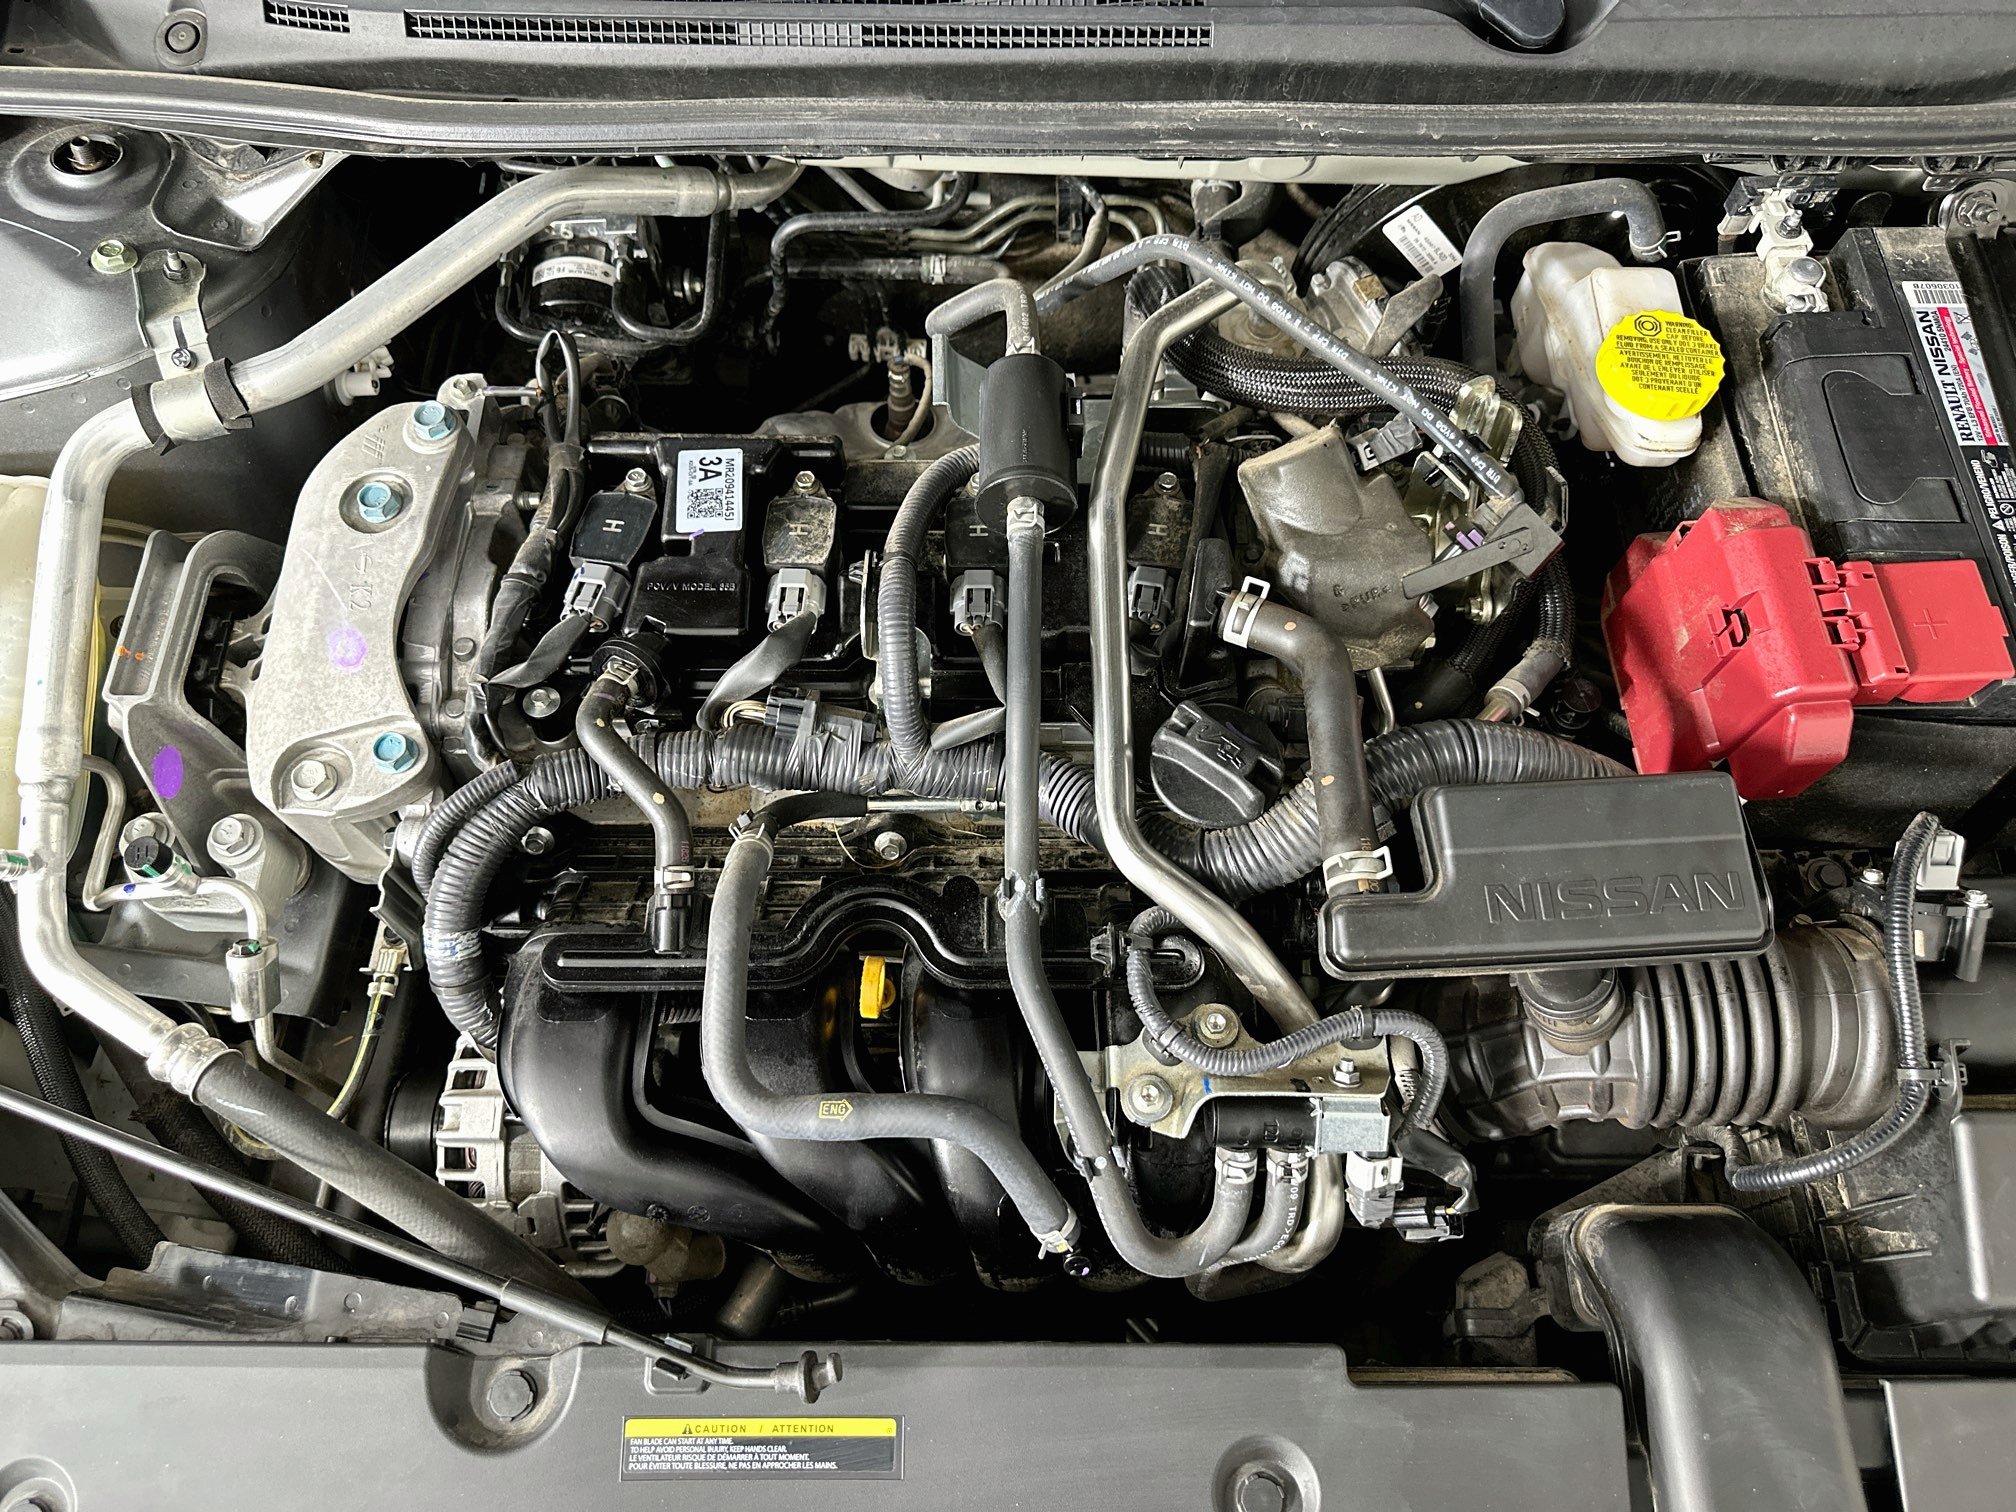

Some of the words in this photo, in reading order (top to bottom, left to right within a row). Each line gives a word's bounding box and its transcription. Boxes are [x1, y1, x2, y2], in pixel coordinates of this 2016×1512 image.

[1916, 310, 1952, 376] NISSAN
[1939, 333, 1952, 352] 24410
[1661, 344, 1684, 353] SEALED
[1686, 347, 1718, 356] CONTAINER
[1955, 344, 1966, 364] Special
[1627, 357, 1654, 365] BOUCHON
[1664, 360, 1706, 370] REMPLISSAGE
[1632, 369, 1666, 378] SEULEMENT
[1688, 368, 1715, 376] UTILISER
[1639, 383, 1674, 392] CONTENANT
[1650, 378, 1686, 386] PROVENANT
[1968, 388, 1982, 410] Flooded
[1941, 380, 1976, 442] RENAULT
[1976, 410, 1992, 438] Enhanced
[1974, 430, 1984, 442] 12V
[699, 456, 722, 482] 3A
[724, 458, 734, 520] MR20941445J
[1970, 460, 2000, 520] PELIGRO/VENENO
[602, 519, 625, 532] H
[789, 522, 809, 536] H
[969, 524, 988, 536] H
[1147, 524, 1168, 536] H
[682, 583, 716, 591] MODEL
[1484, 871, 1746, 923] NISSAN
[822, 1104, 846, 1114] ENG
[695, 1424, 746, 1433] CAUTION
[772, 1424, 834, 1432] ATTENTION
